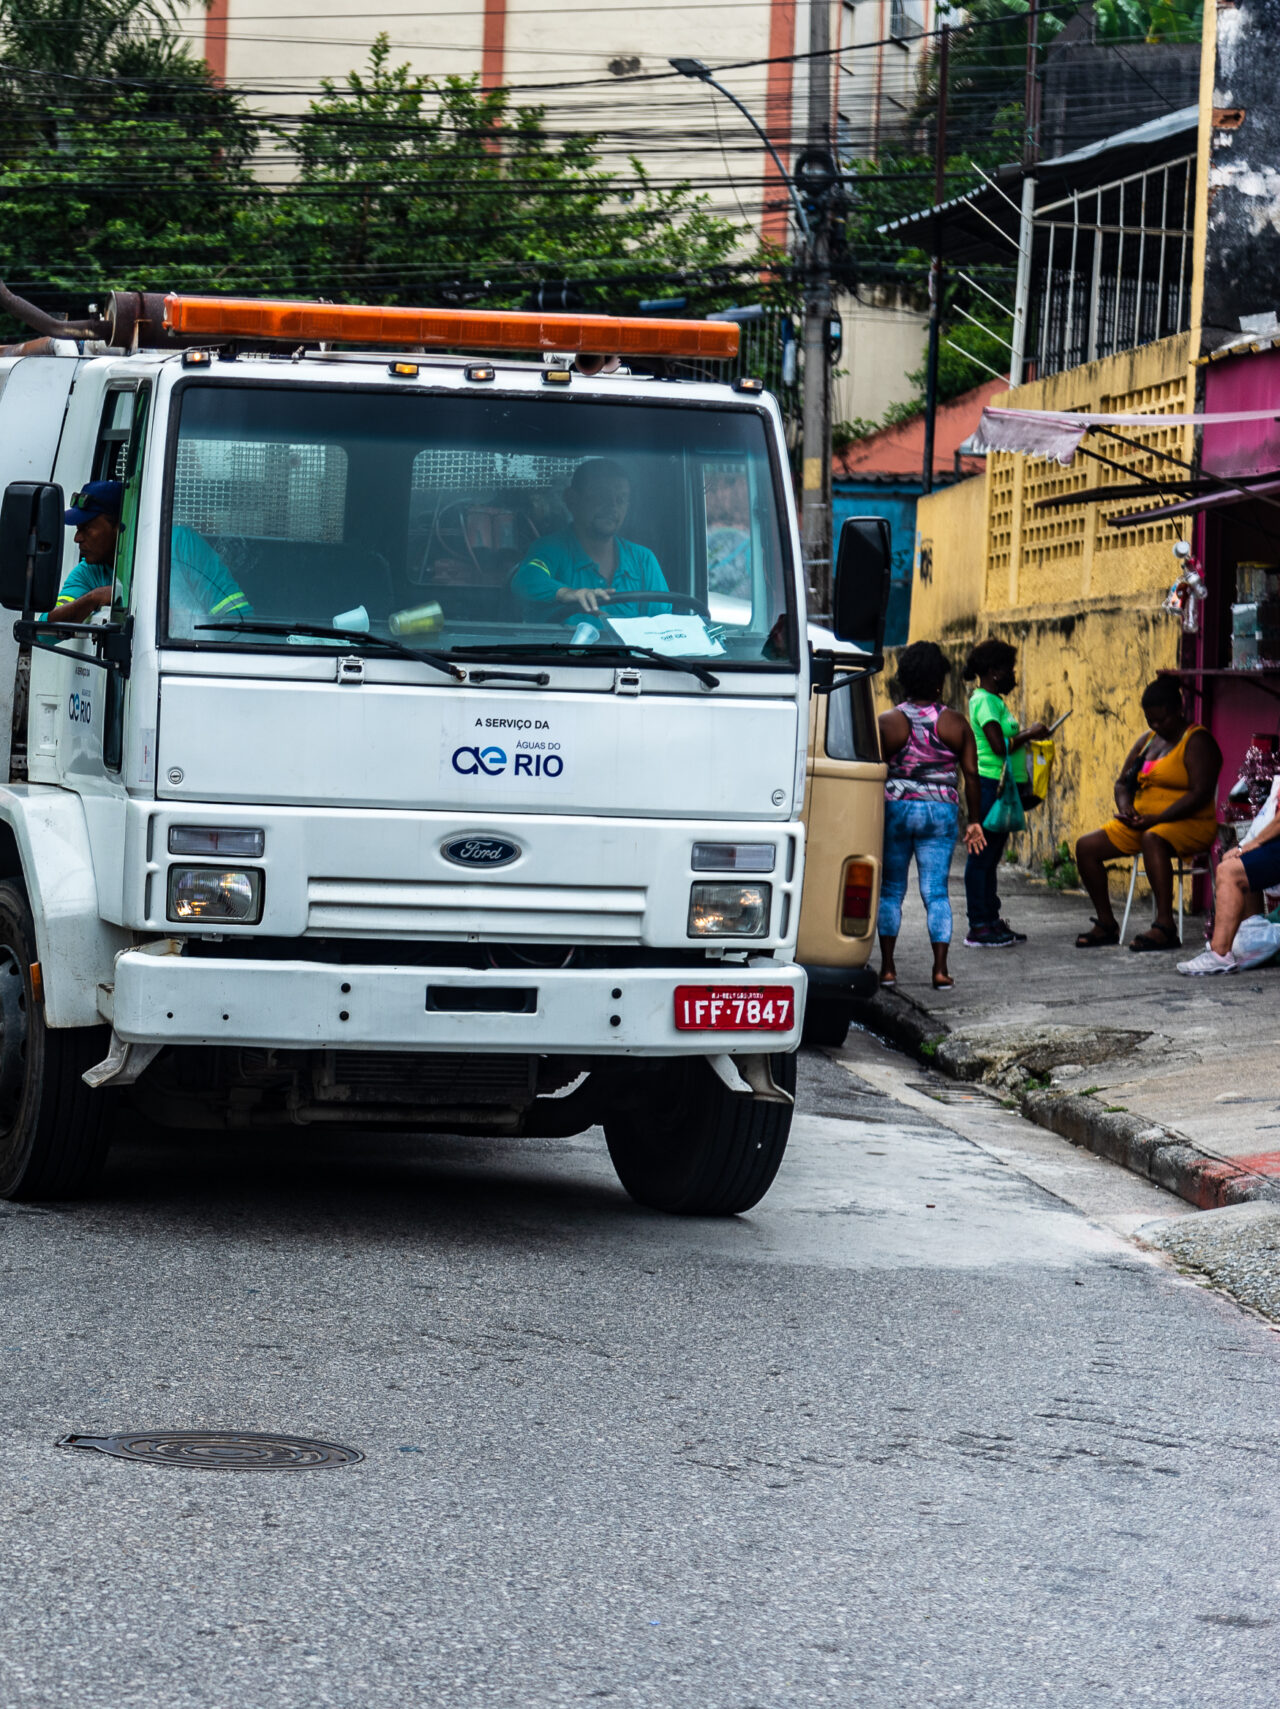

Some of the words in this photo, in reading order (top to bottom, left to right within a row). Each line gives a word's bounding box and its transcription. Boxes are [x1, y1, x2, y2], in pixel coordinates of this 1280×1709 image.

[475, 718, 483, 727] A
[485, 718, 532, 731] SERVIÇO
[534, 720, 550, 730] DA
[516, 740, 546, 750] ÁGUAS
[548, 742, 561, 751] DO
[514, 754, 564, 778] RIO
[460, 840, 503, 859] Ford
